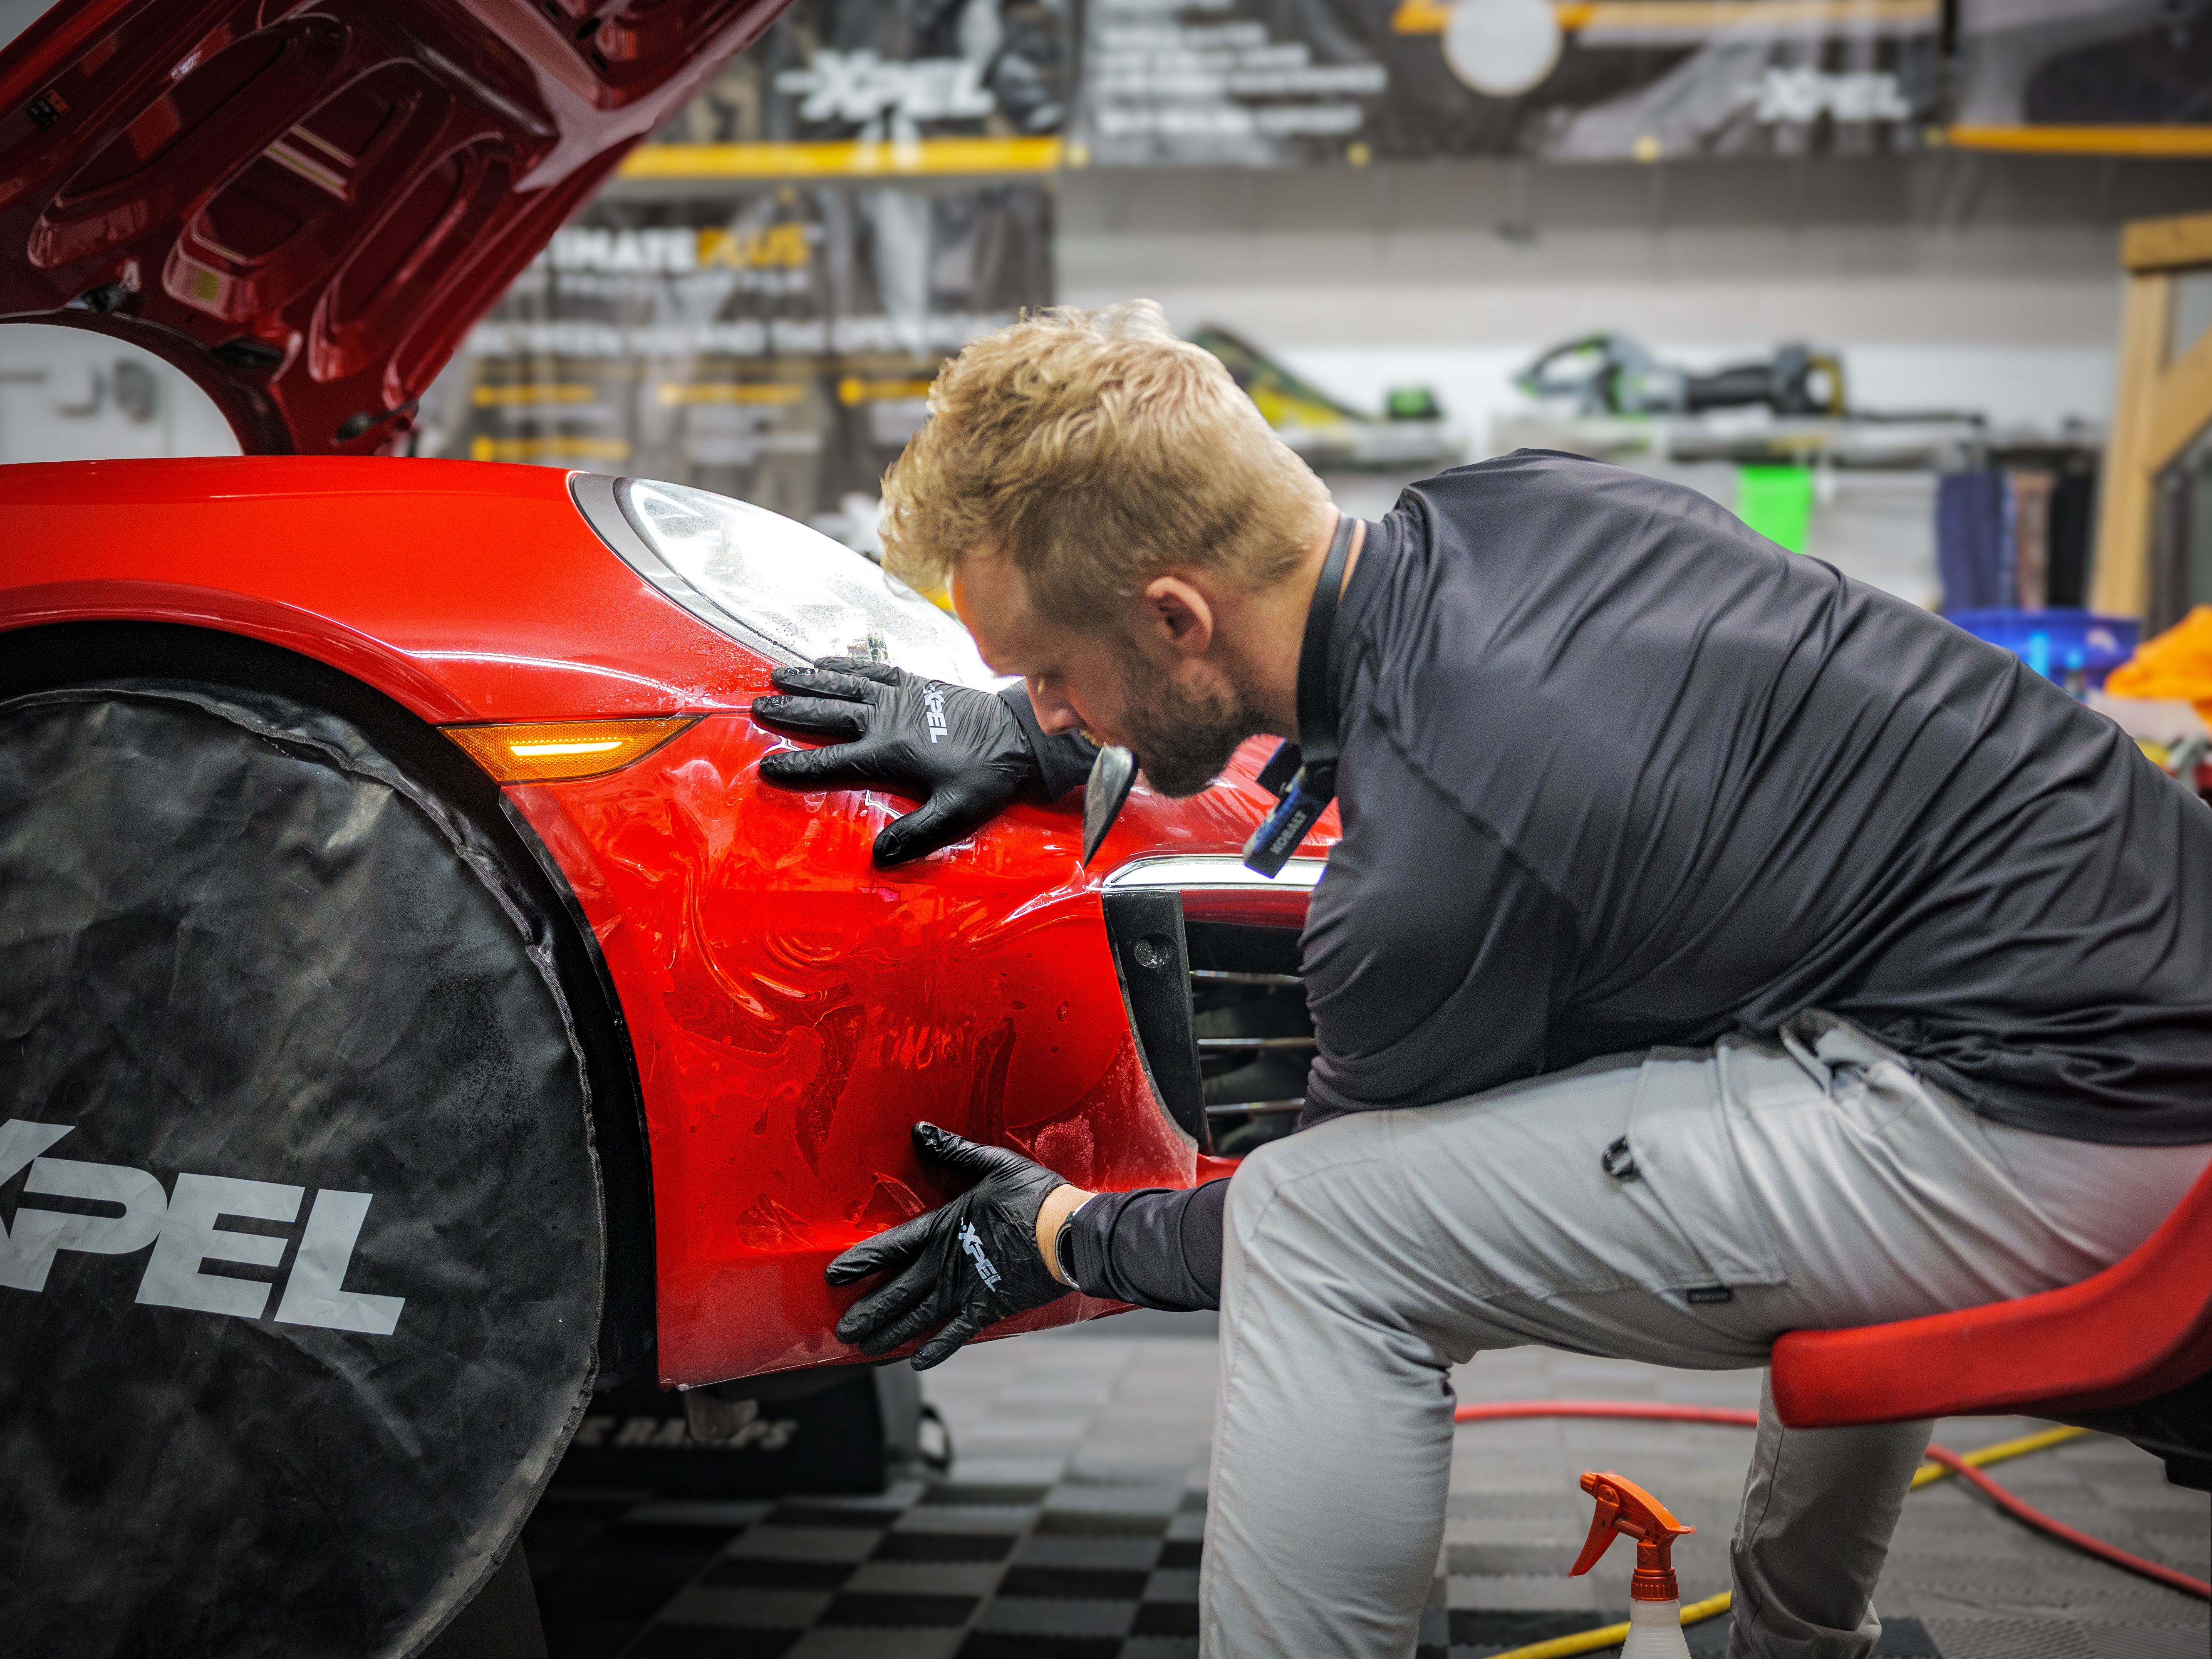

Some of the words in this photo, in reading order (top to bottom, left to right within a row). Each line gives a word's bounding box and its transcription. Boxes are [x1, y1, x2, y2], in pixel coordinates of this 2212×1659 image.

[533, 227, 696, 272] IMATE
[923, 683, 949, 743] XPEL
[958, 1218, 1001, 1292] XPEL
[616, 1416, 798, 1449] RAPS
